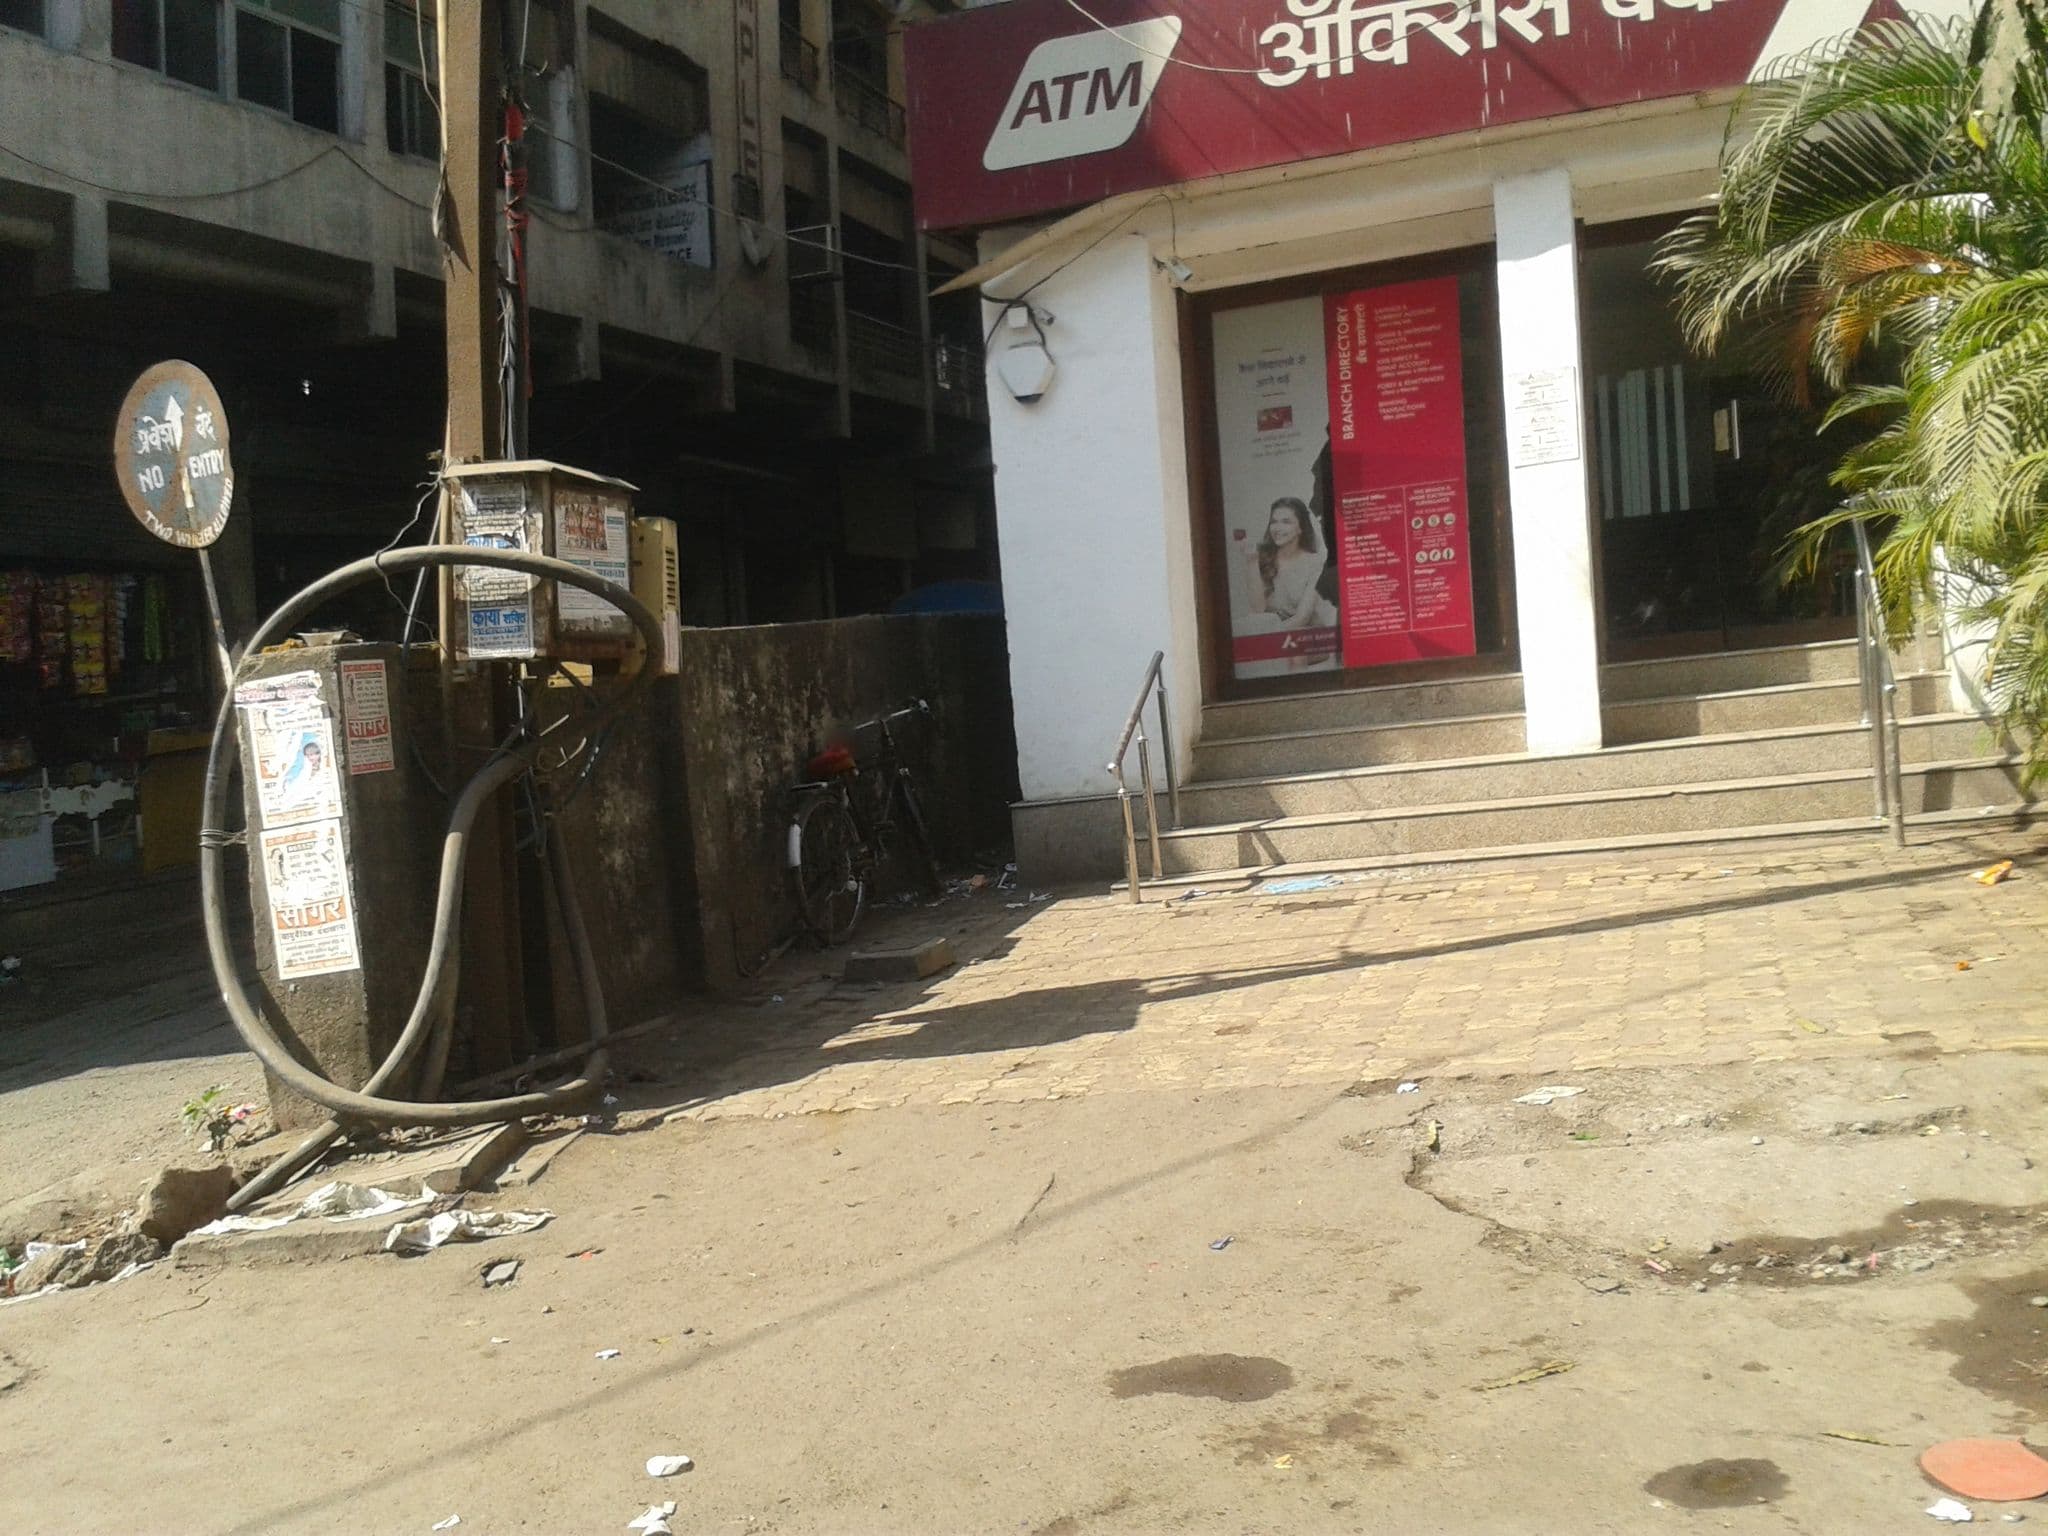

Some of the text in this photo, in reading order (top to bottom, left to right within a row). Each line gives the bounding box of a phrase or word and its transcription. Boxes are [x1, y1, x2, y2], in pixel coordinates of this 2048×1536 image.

[1009, 61, 1143, 130] ATM
[1336, 307, 1355, 440] BRANCH DIRECTORY
[138, 448, 225, 493] NO ENTRY
[144, 510, 173, 540] TWO
[471, 609, 501, 627] काया
[350, 718, 386, 737] सागर
[278, 899, 342, 929] सागर
